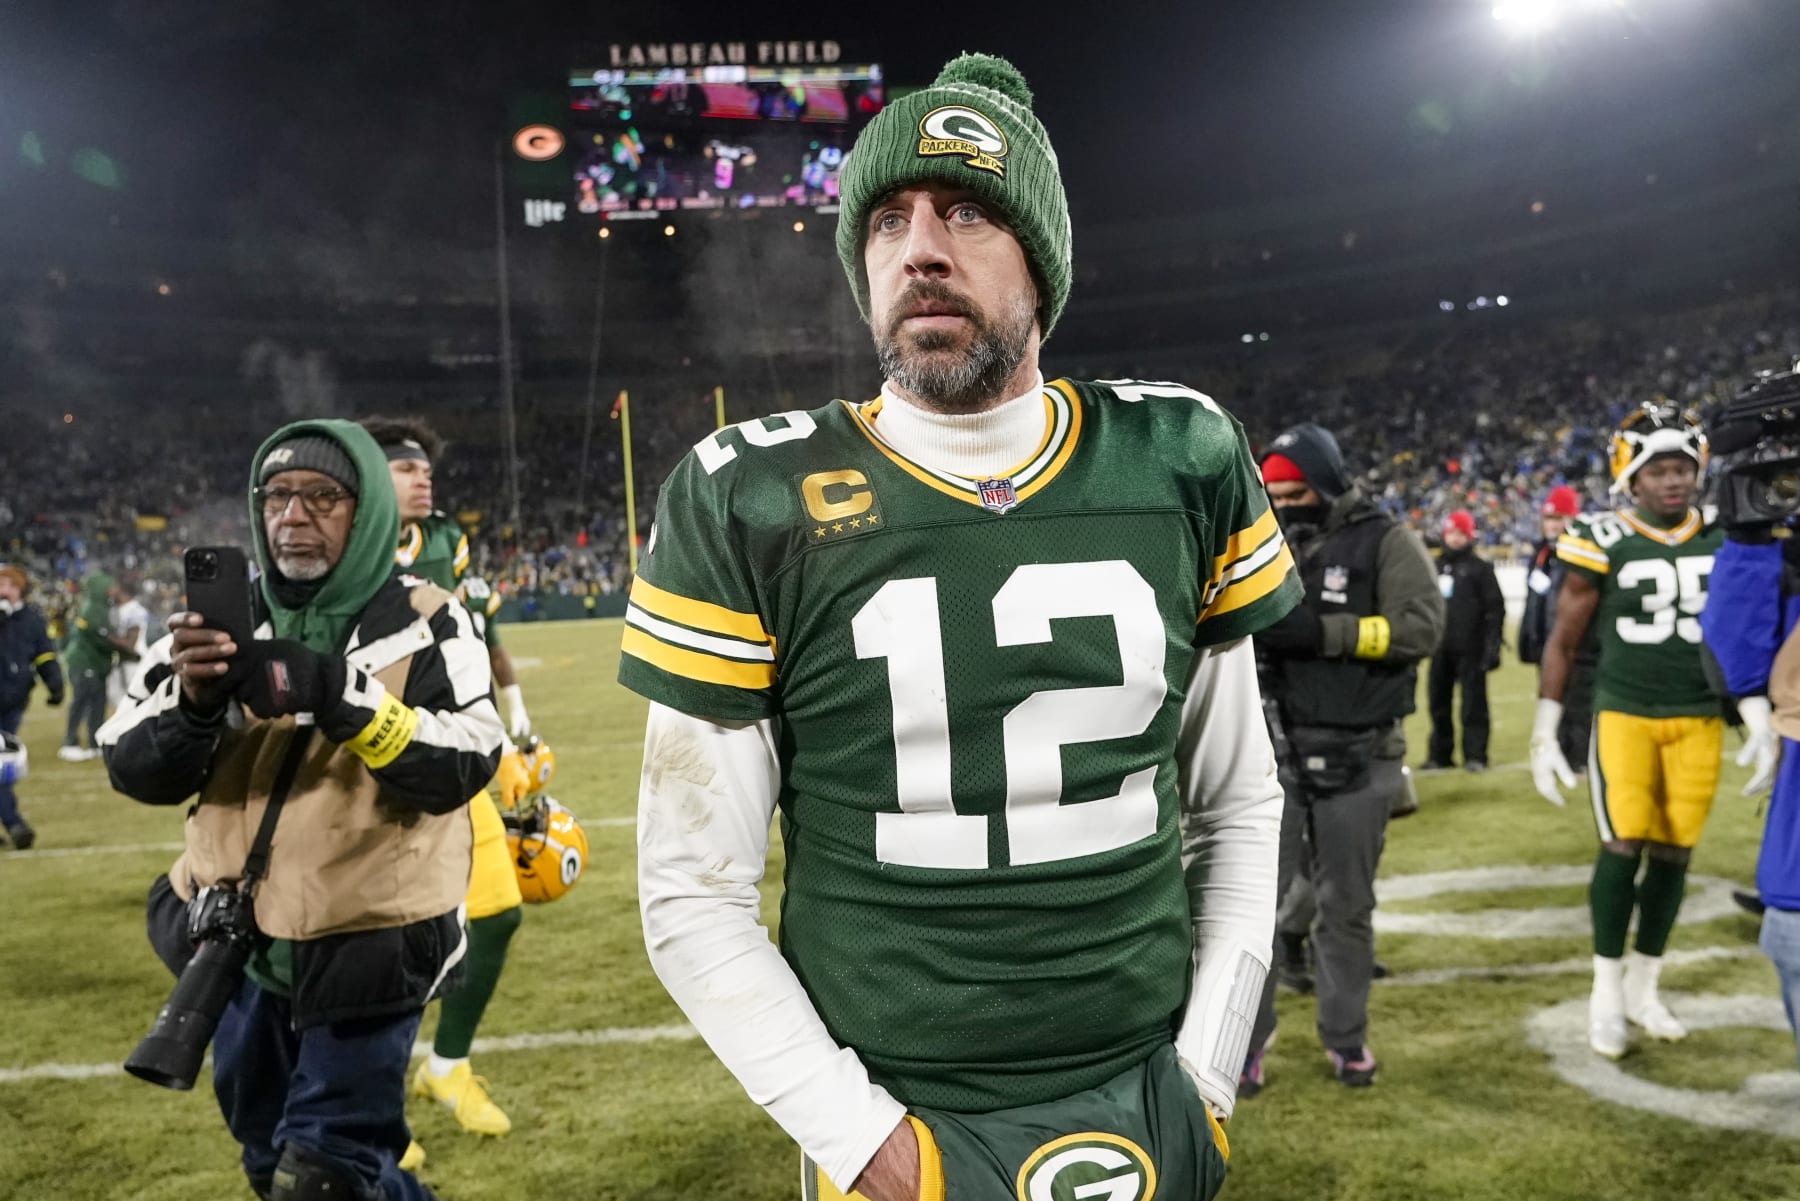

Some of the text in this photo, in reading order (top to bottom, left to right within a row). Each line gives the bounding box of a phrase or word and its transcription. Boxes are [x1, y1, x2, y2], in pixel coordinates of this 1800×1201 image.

[610, 41, 841, 66] LAMBEAU FIELD
[921, 140, 977, 154] PACKERS
[979, 156, 1000, 168] NFC
[524, 198, 566, 227] Lite
[801, 469, 872, 522] C
[984, 488, 1012, 505] NFL
[1616, 555, 1716, 644] 35
[851, 559, 1168, 870] 12
[365, 717, 396, 749] WEEK
